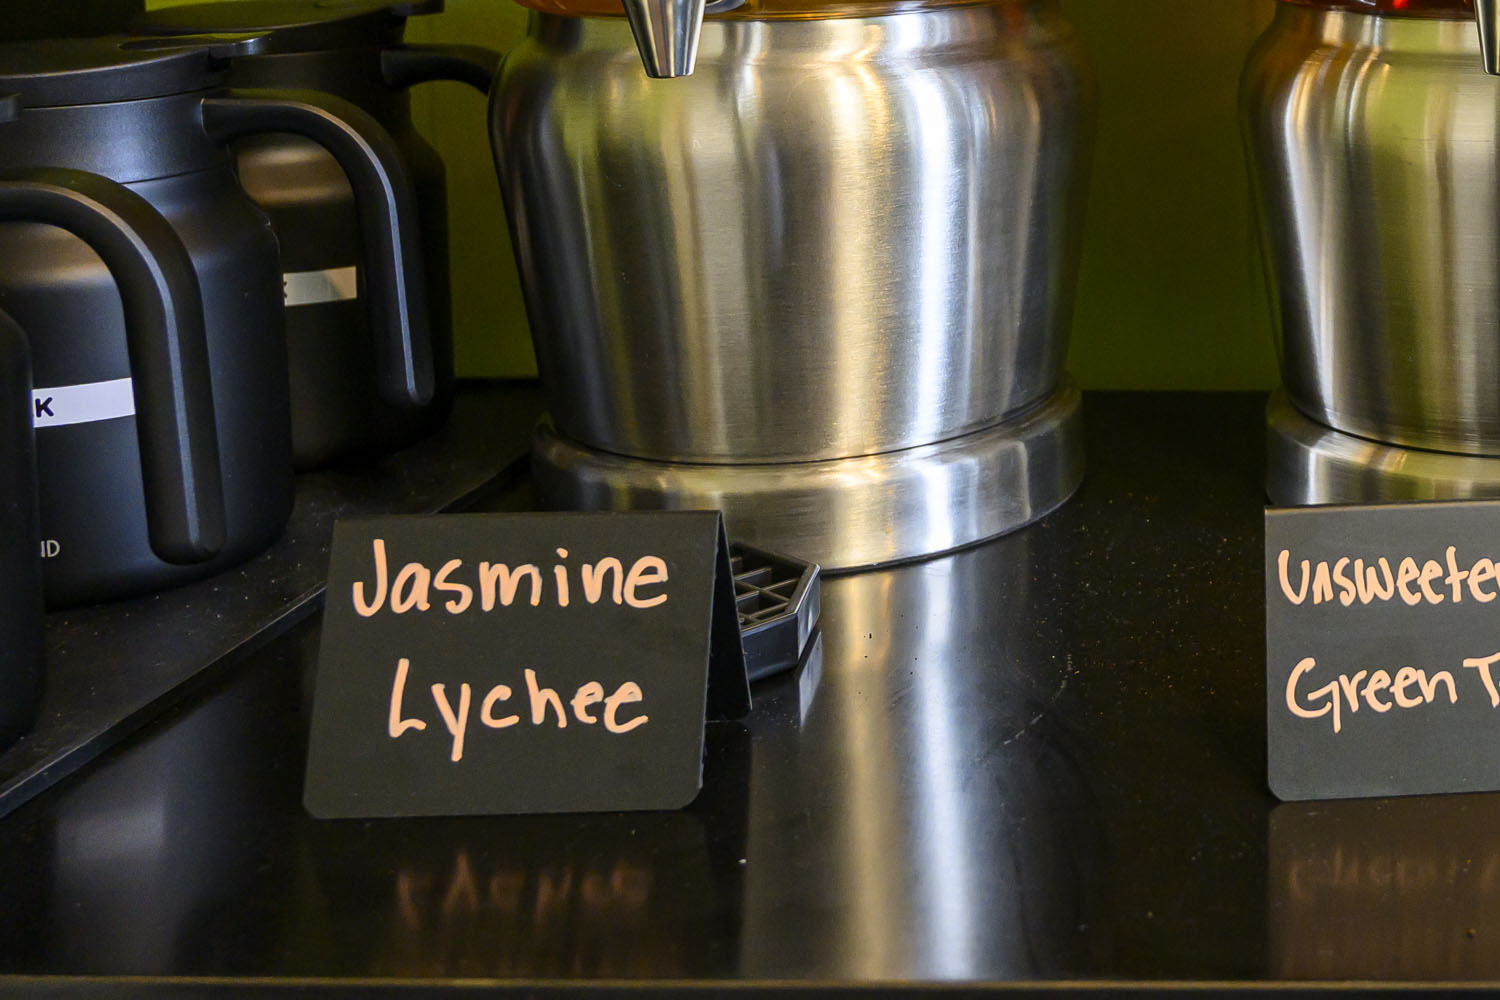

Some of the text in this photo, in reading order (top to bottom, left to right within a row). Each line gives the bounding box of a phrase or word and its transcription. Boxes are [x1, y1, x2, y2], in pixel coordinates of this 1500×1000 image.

[354, 539, 667, 616] Jasmine
[390, 659, 648, 761] Lychee
[1286, 658, 1457, 733] Green
